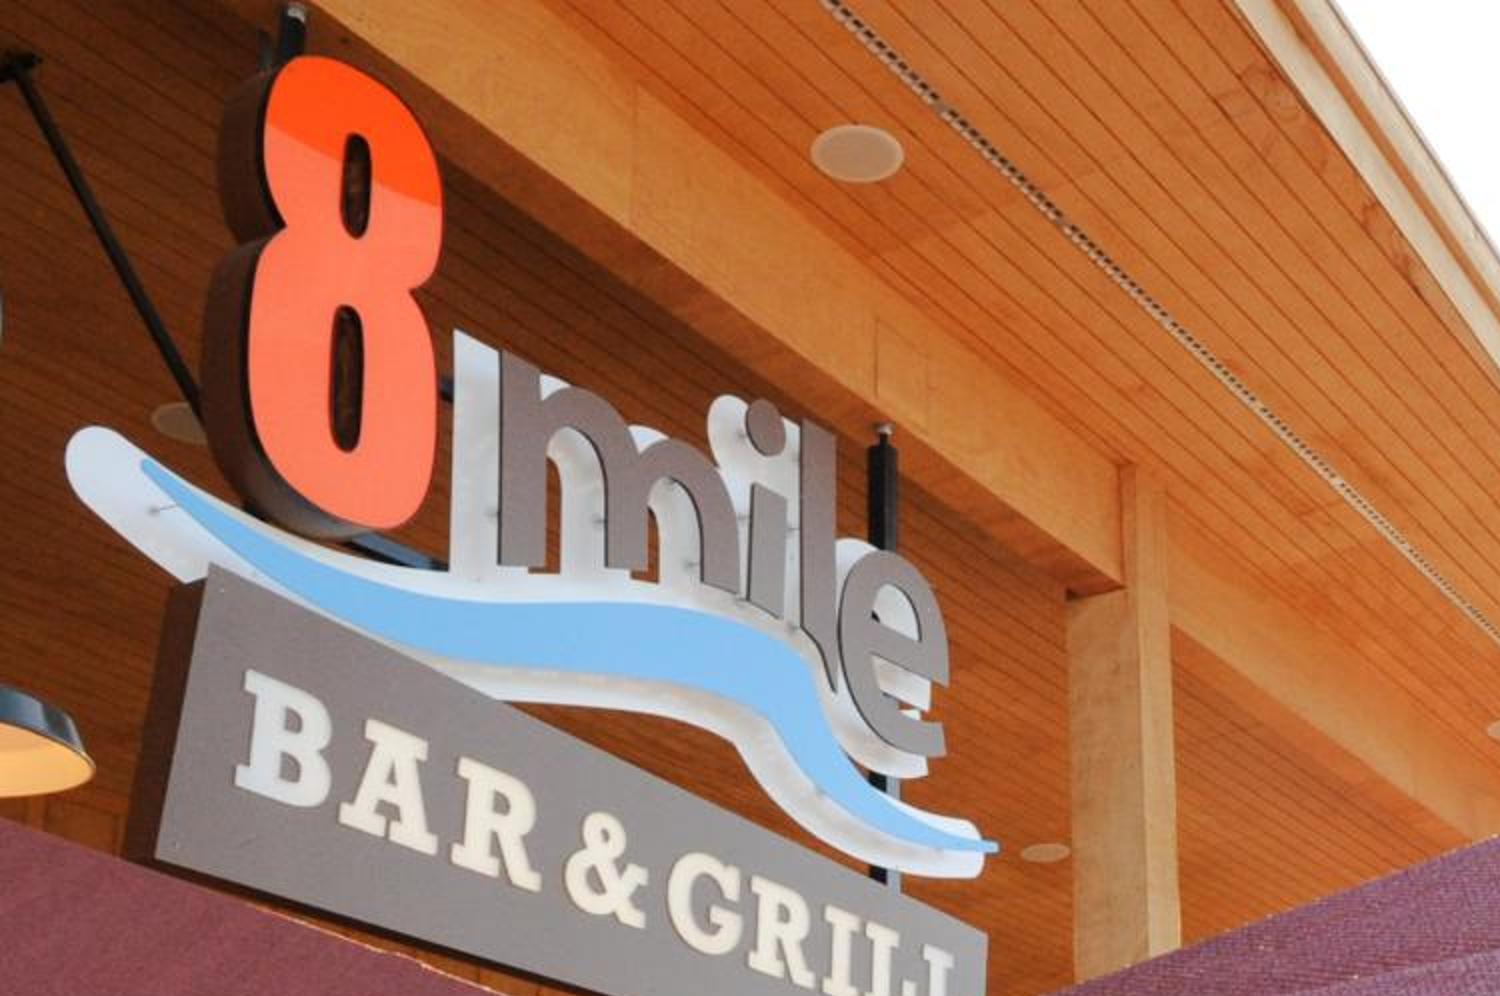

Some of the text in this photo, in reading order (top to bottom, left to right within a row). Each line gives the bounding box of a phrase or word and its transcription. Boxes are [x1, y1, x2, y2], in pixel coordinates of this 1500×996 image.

[246, 54, 951, 760] 8 mile
[234, 669, 541, 893] BAR
[563, 811, 648, 930] &
